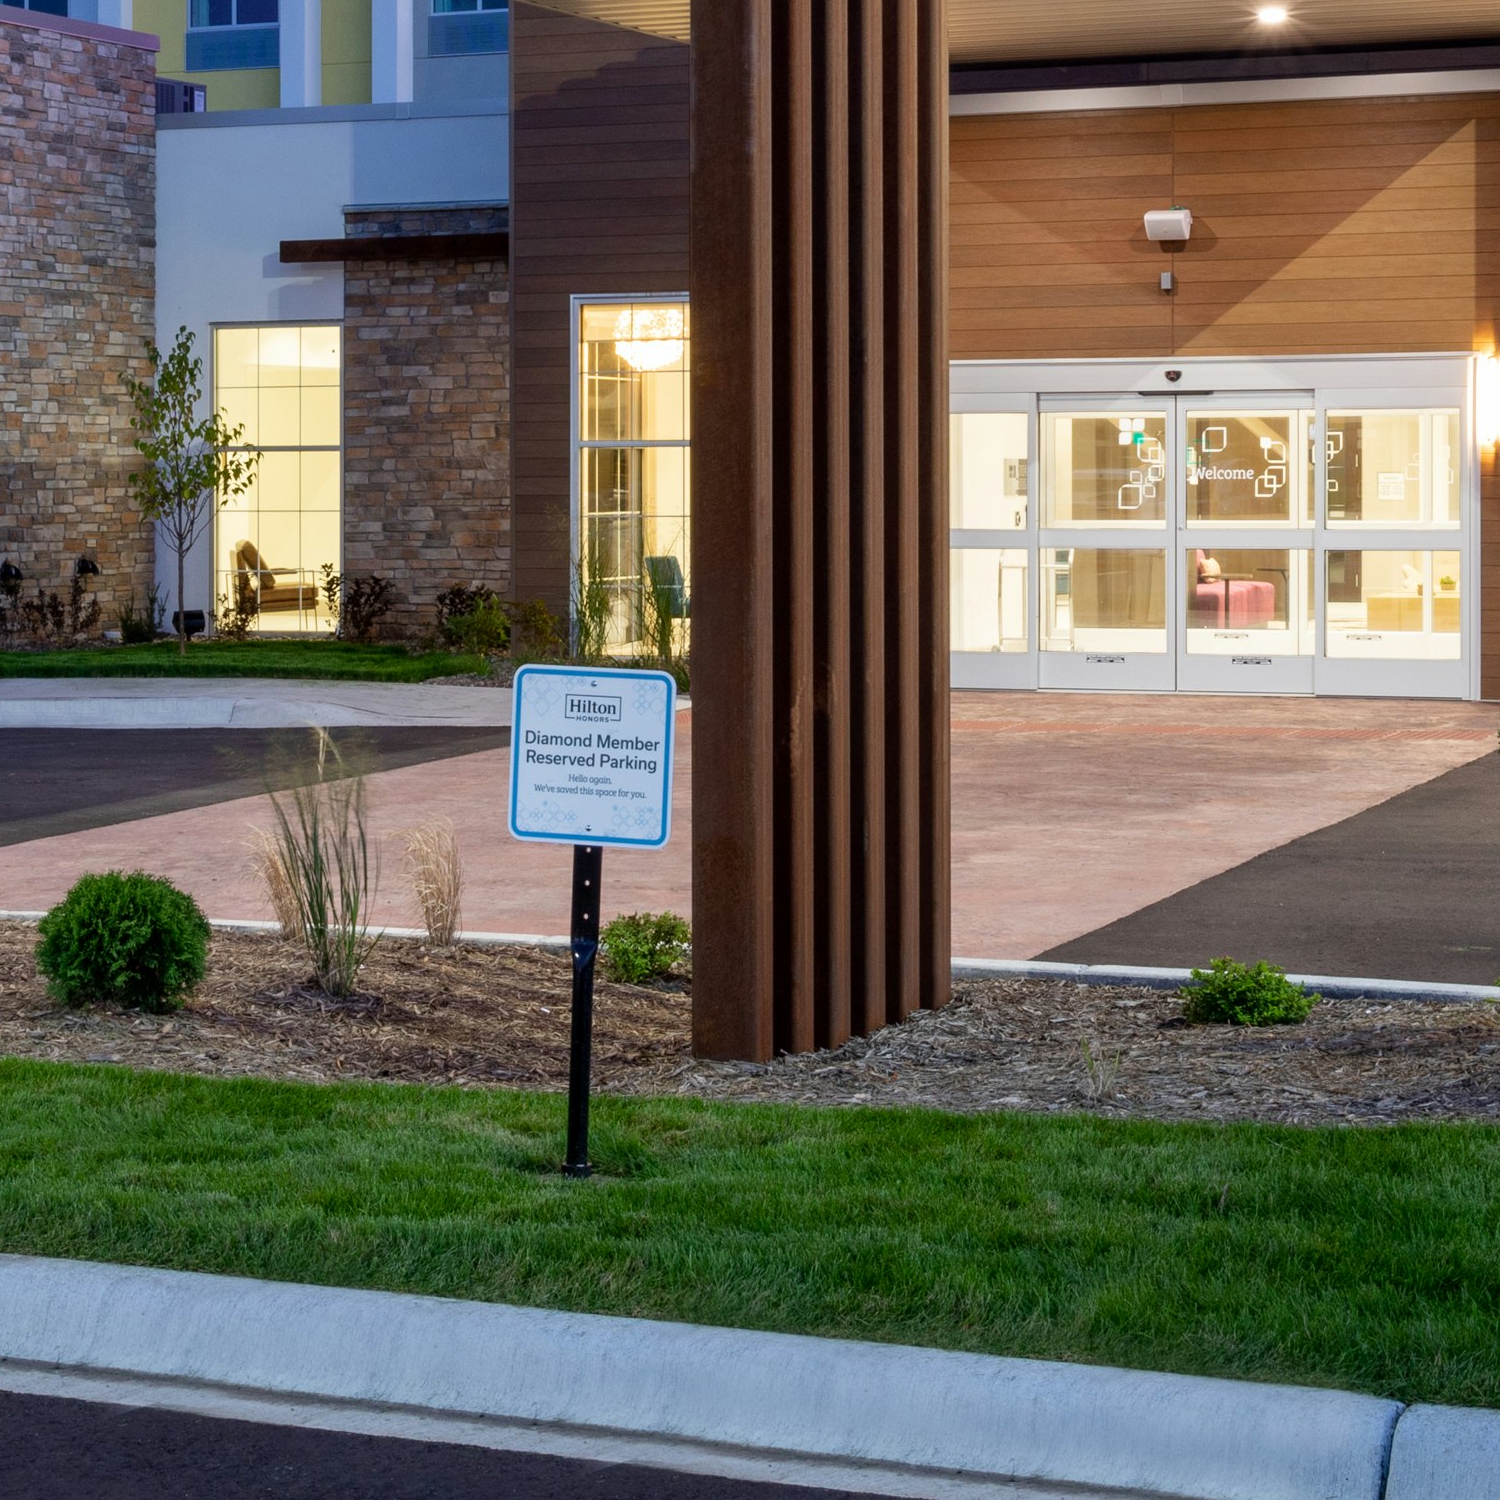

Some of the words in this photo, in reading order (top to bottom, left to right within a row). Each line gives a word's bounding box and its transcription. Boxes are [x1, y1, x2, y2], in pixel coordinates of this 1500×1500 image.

[1192, 466, 1255, 480] Welcome
[570, 699, 616, 715] Hilton
[576, 715, 609, 723] HONORS
[525, 730, 592, 747] Diamond
[597, 735, 660, 751] Member
[526, 750, 595, 767] Reserved
[600, 754, 657, 773] Parking
[568, 774, 588, 783] Hello
[589, 775, 612, 785] again.
[534, 784, 556, 792] We've
[556, 786, 578, 794] saved
[580, 786, 594, 795] this
[595, 789, 617, 798] space
[618, 788, 629, 797] for
[630, 791, 646, 800] you.
